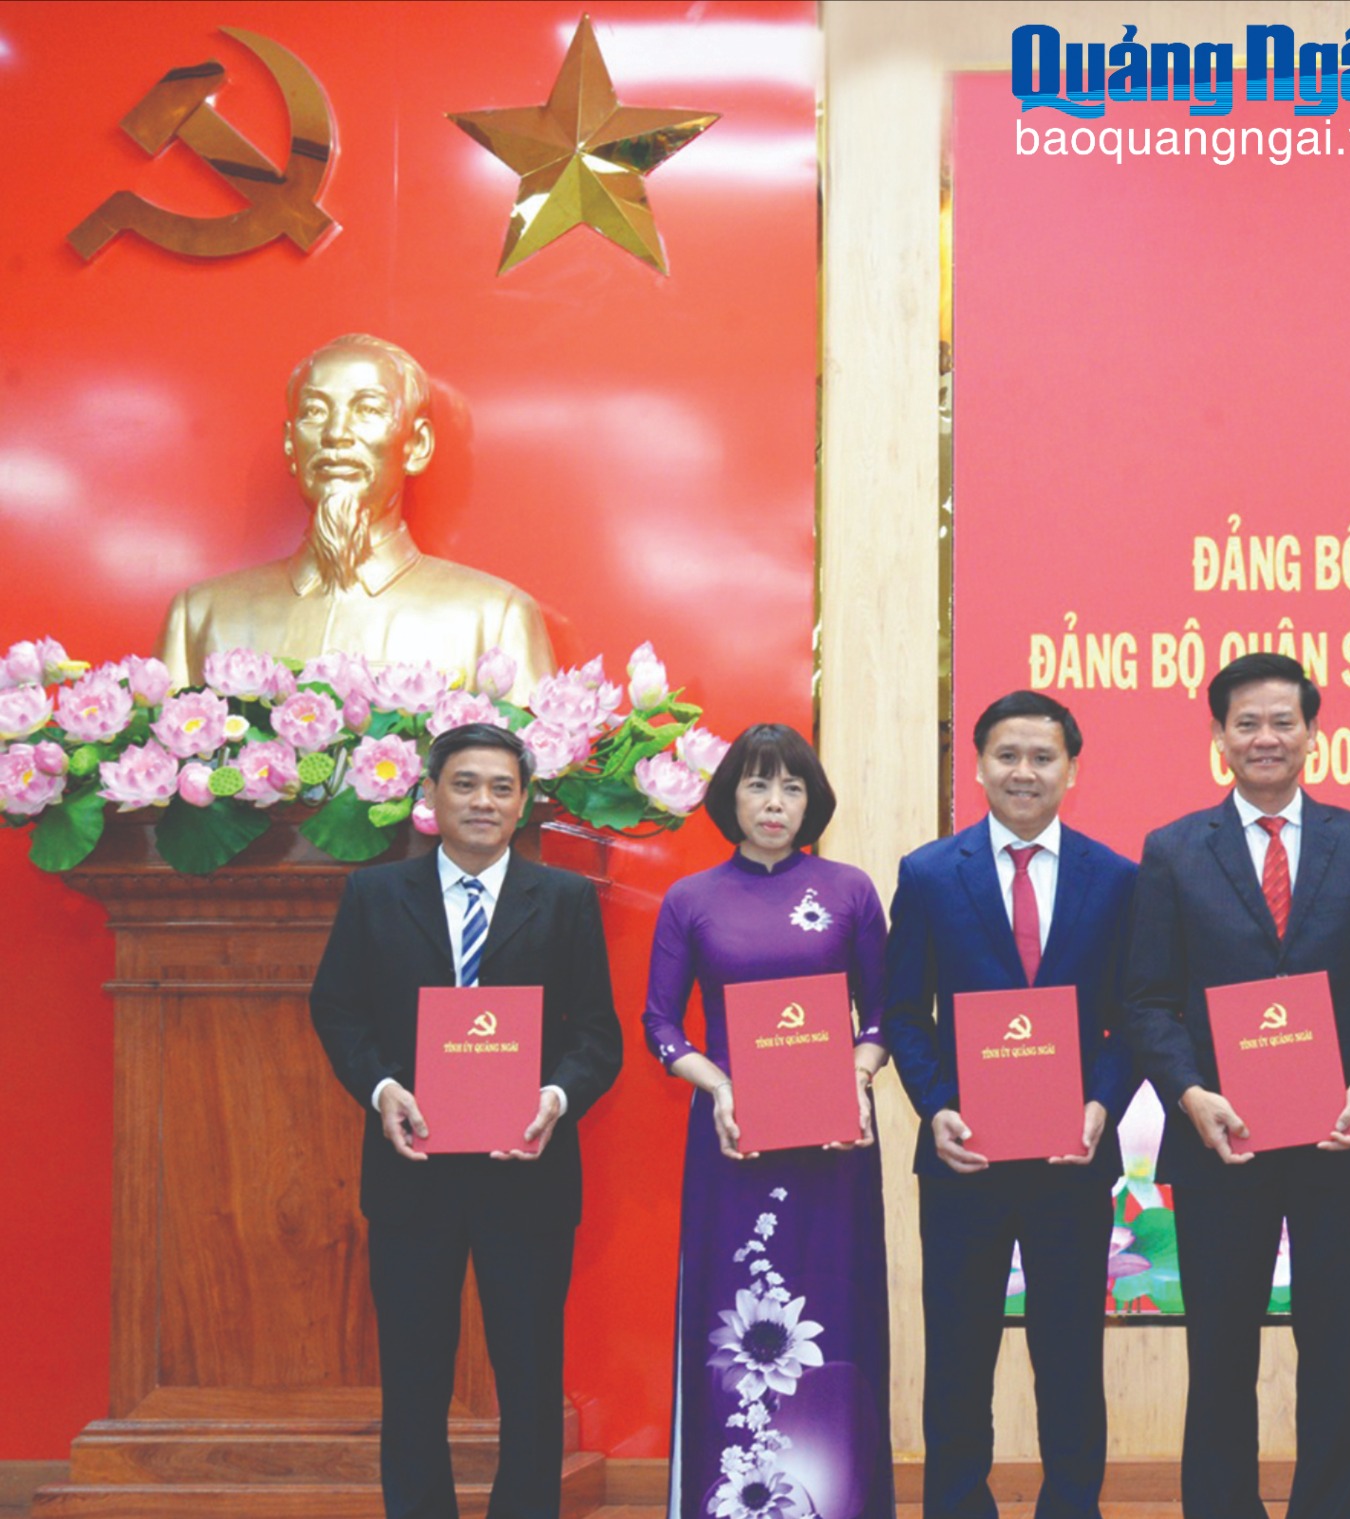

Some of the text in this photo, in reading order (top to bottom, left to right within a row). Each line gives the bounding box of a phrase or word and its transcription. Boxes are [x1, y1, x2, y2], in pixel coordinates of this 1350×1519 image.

[1192, 514, 1301, 591] ĐẢNG
[1029, 612, 1137, 689] ĐẢNG
[1152, 617, 1205, 699] BỘ
